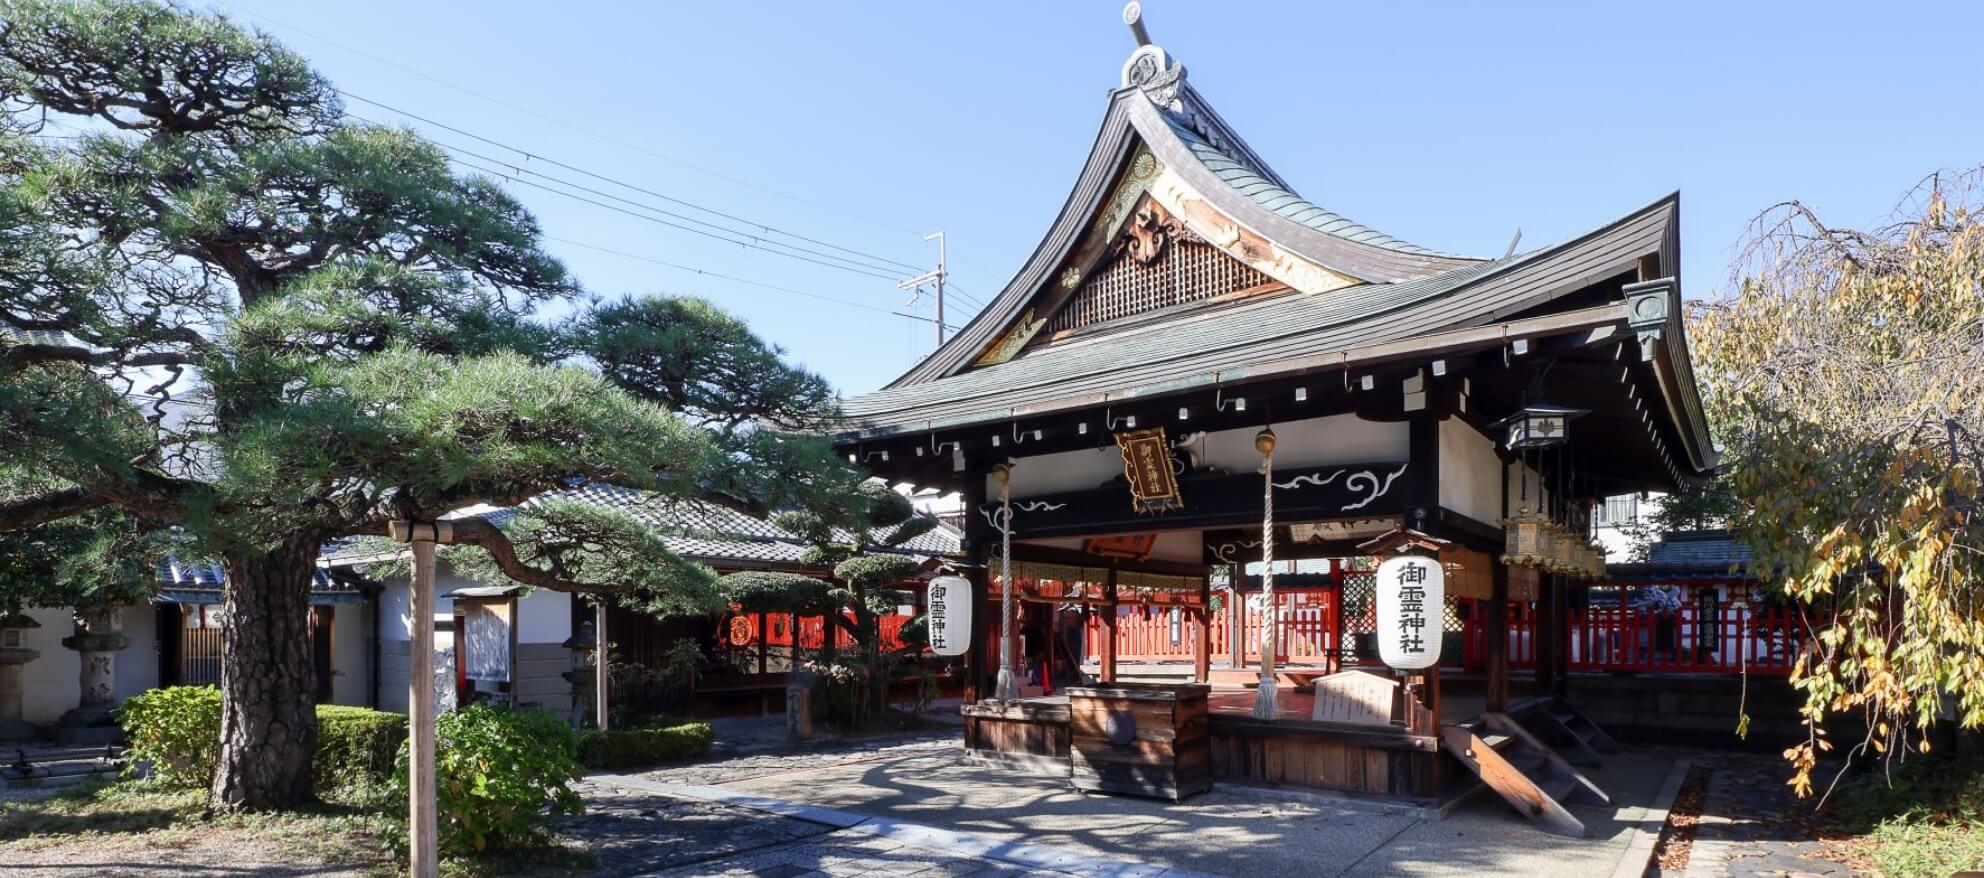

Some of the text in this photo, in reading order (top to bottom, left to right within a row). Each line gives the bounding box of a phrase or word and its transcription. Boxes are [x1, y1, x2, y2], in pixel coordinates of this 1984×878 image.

[1141, 444, 1162, 493] 御霊神社
[930, 583, 947, 650] 御霊神社
[1396, 561, 1427, 654] 御霊神社
